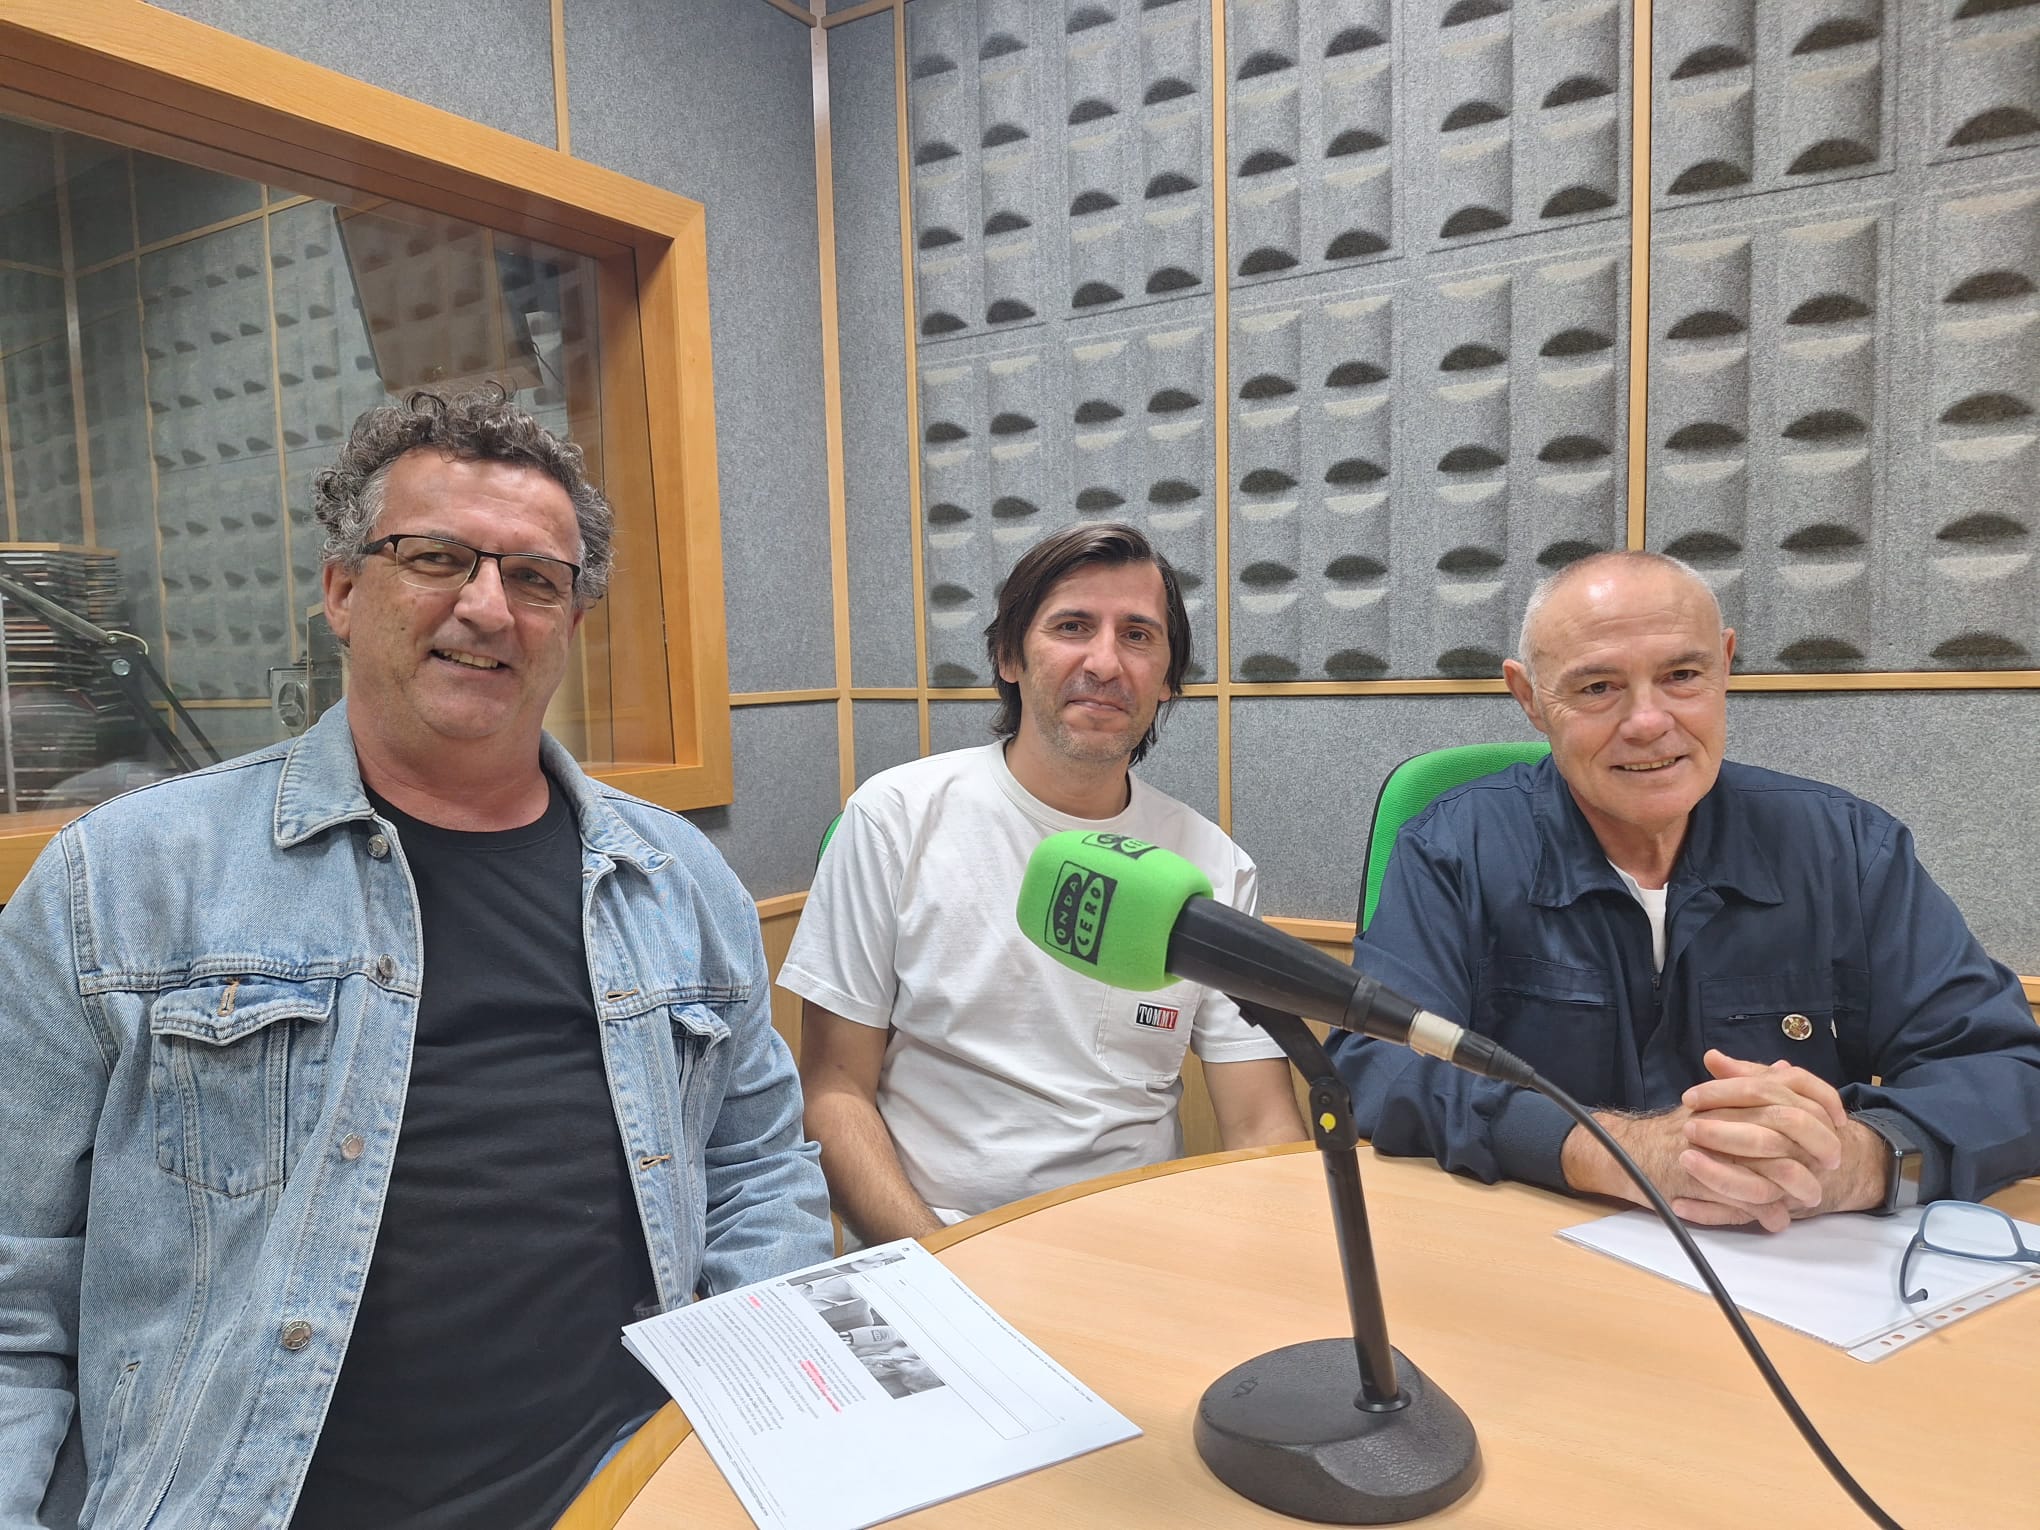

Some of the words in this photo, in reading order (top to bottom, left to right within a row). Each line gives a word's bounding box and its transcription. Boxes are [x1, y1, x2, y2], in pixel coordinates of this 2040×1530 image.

[1056, 881, 1079, 939] ONDA
[1077, 887, 1101, 946] CERO
[1139, 1005, 1177, 1028] TOMMY
